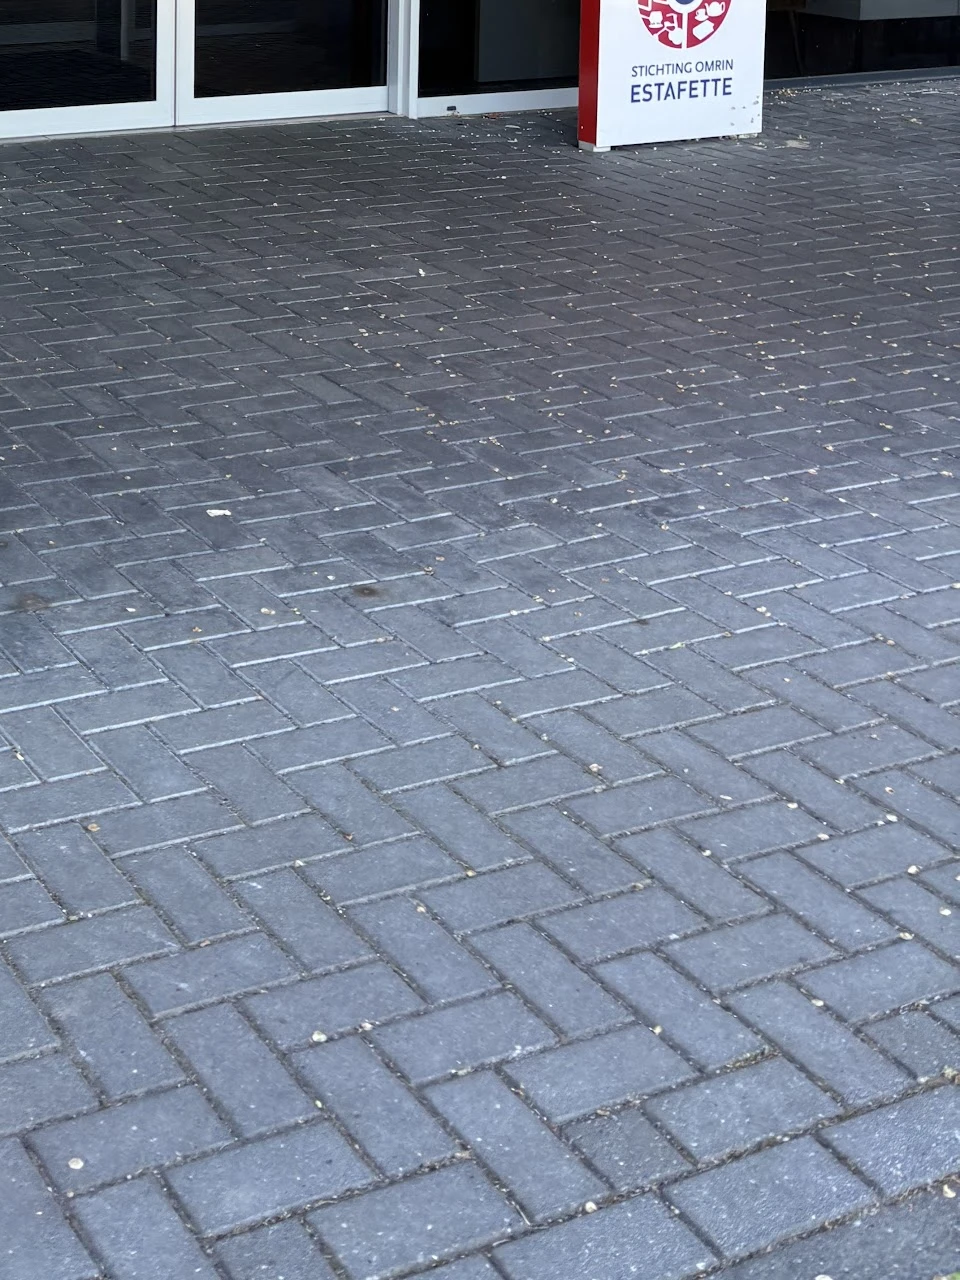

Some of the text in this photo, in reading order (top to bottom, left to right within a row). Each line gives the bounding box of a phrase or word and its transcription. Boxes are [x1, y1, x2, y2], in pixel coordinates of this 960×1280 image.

[631, 58, 734, 78] STICHTING OMRIN
[630, 77, 733, 104] ESTAFETTE
